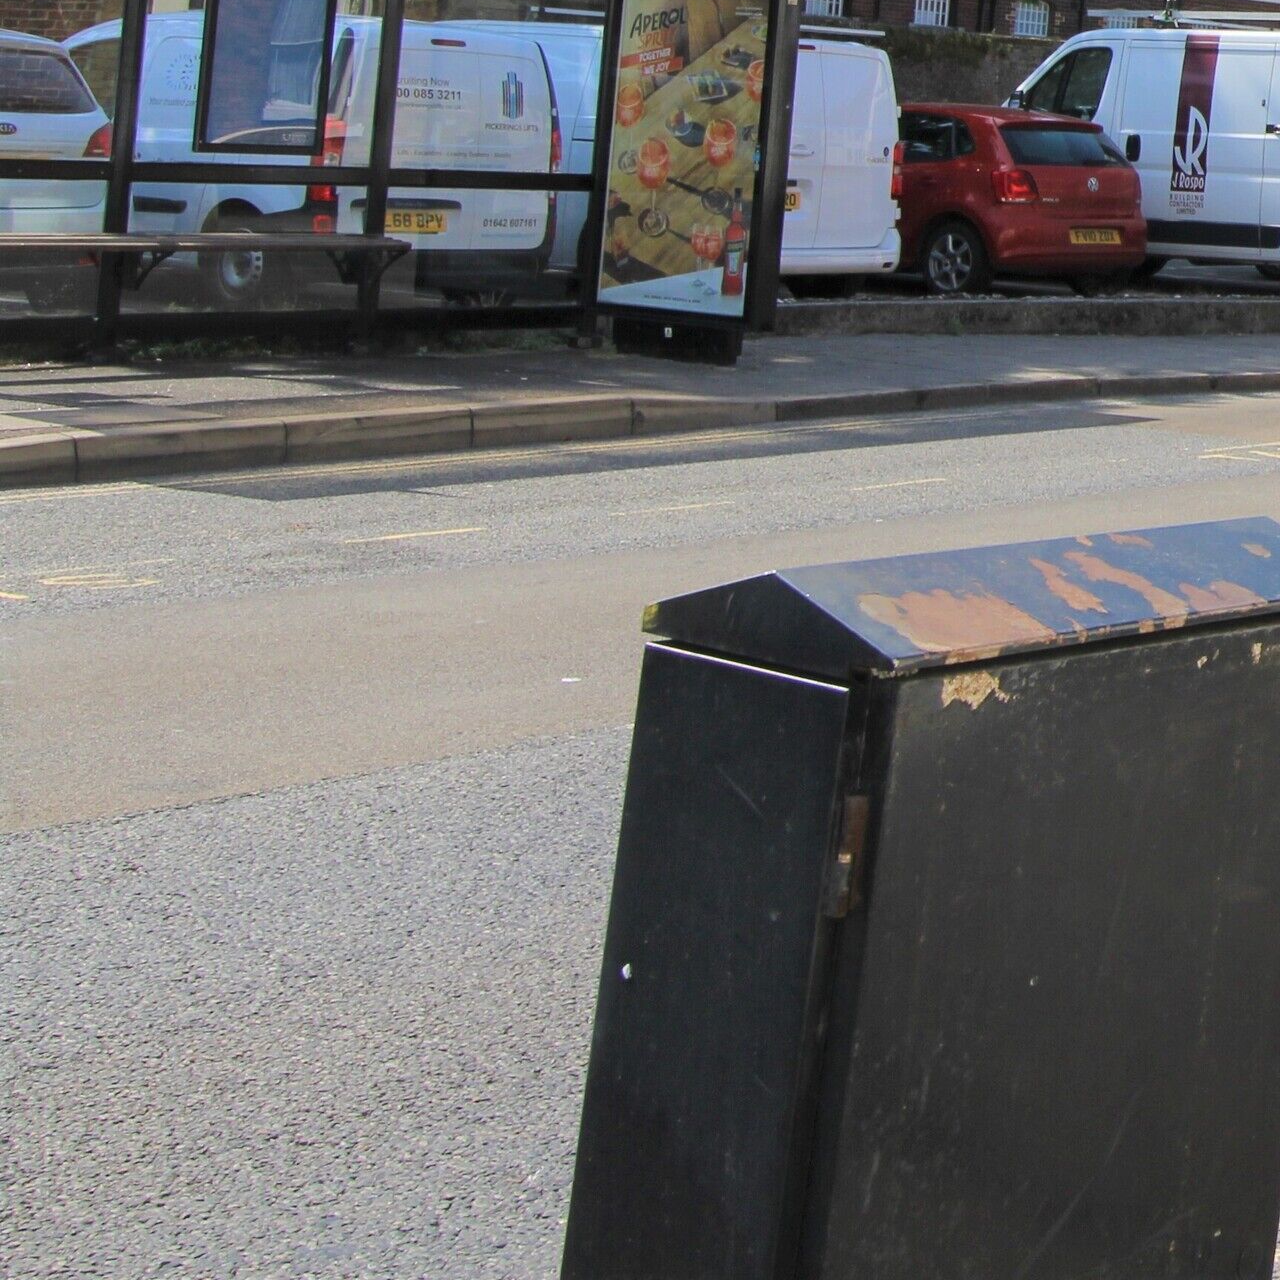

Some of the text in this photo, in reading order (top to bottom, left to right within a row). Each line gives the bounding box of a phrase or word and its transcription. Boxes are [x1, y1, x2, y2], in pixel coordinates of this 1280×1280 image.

[630, 7, 687, 39] APEROL
[397, 77, 428, 87] ruiting
[413, 89, 434, 99] 085
[437, 90, 462, 100] 3211
